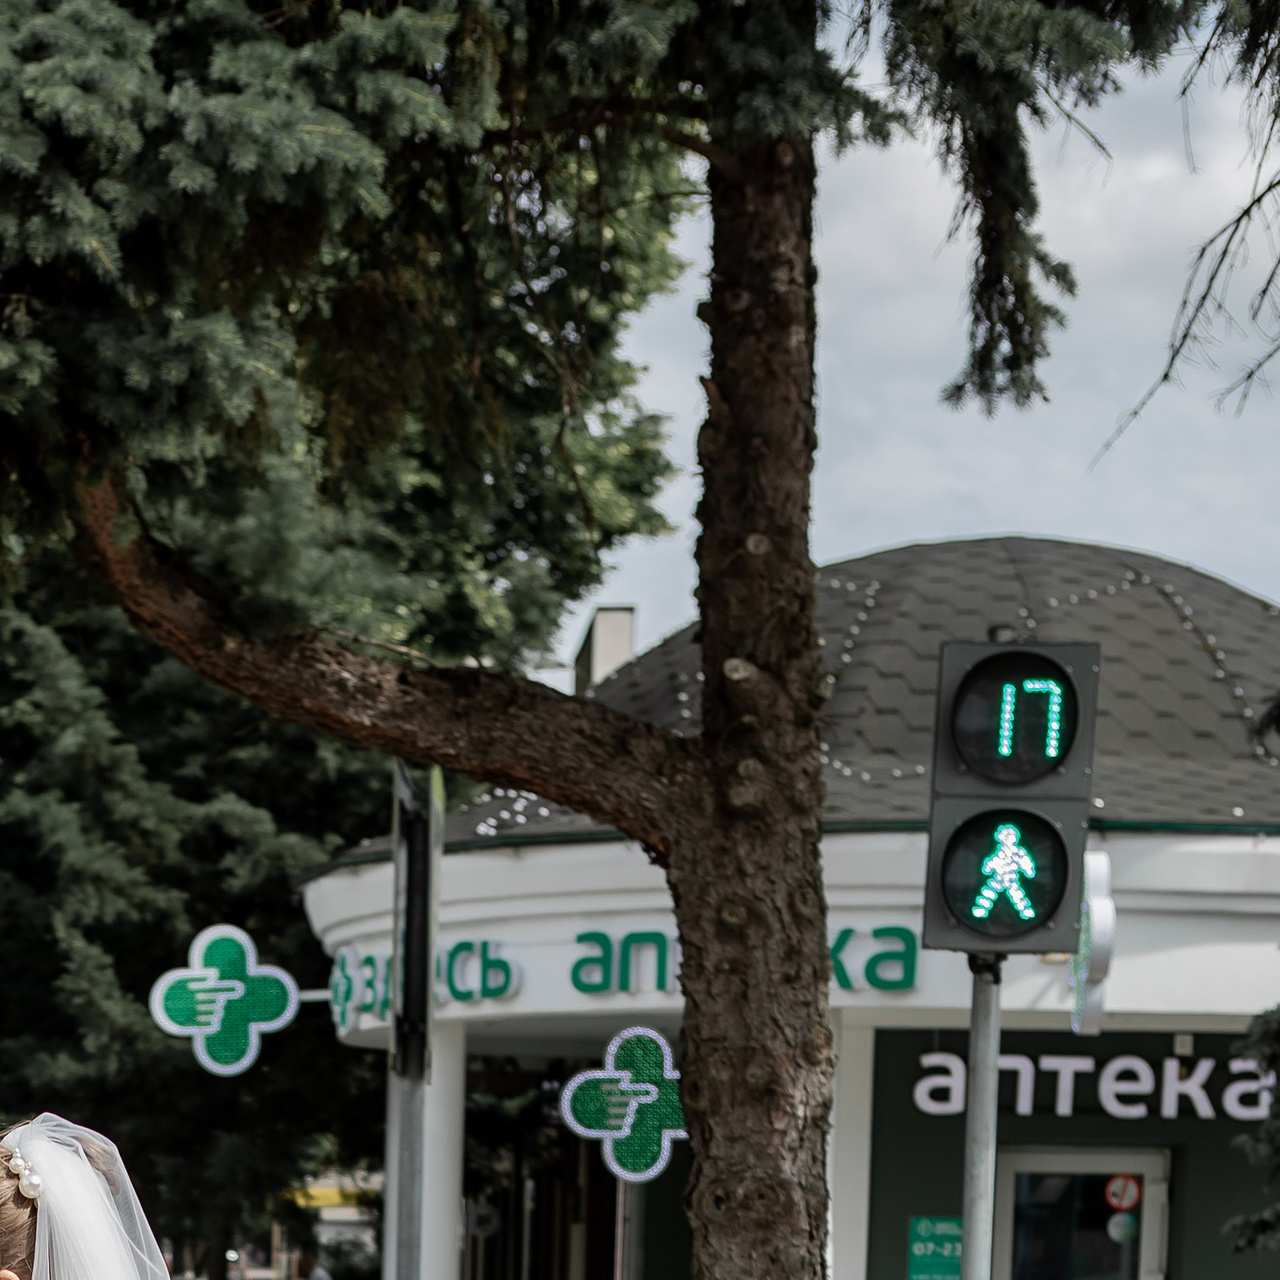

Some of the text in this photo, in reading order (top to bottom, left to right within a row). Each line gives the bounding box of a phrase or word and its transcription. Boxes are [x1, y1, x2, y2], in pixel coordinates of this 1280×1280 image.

[999, 679, 1062, 757] 17
[359, 925, 917, 1021] зсь апка
[913, 1051, 1278, 1121] аптека
